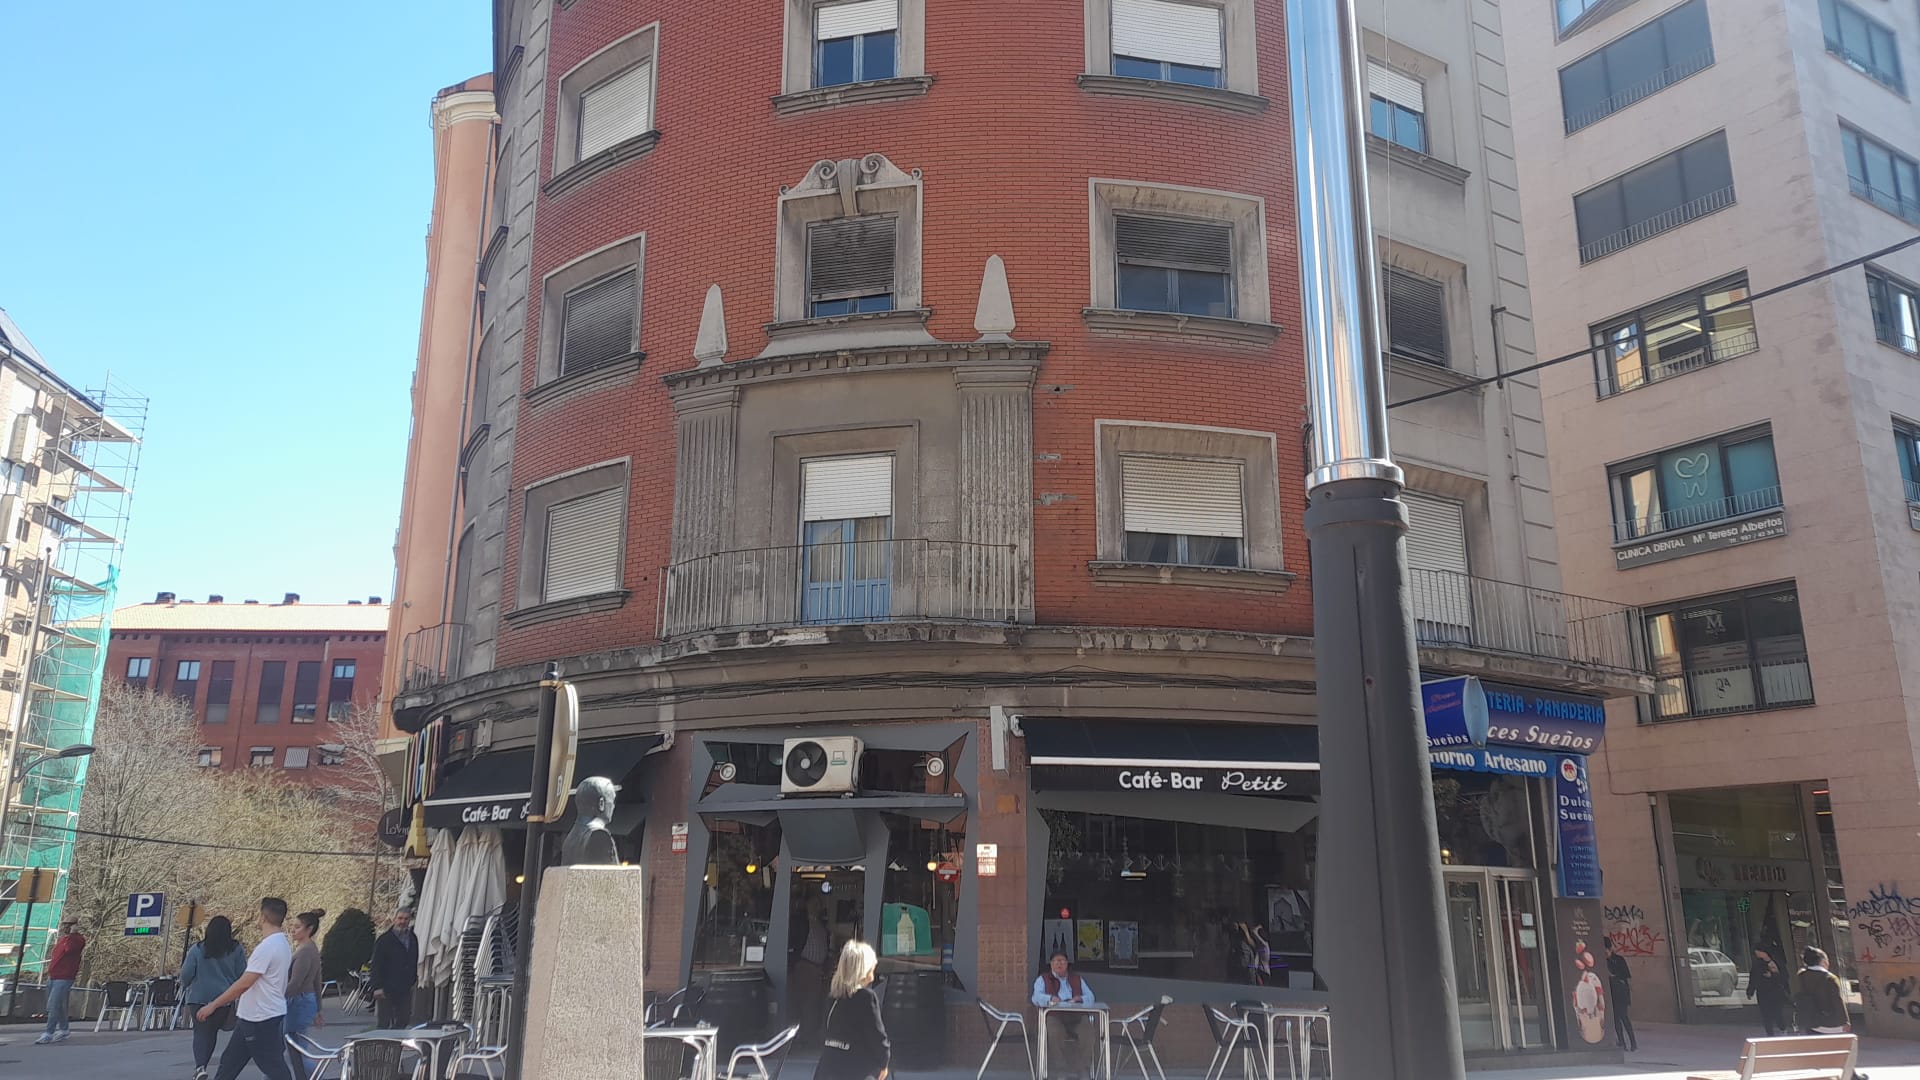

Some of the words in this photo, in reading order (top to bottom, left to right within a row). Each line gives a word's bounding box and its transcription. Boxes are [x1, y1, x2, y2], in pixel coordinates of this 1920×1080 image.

[1617, 546, 1652, 561] CLINICA
[1653, 538, 1686, 553] DENTAL
[1707, 528, 1739, 541] Teresa
[1741, 517, 1784, 534] Albertos
[1487, 691, 1524, 714] TERIA
[1536, 697, 1605, 724] PANADERIA
[1426, 732, 1469, 747] Sueños
[1487, 726, 1520, 740] ces
[1525, 725, 1593, 749] Sueños
[1484, 751, 1548, 774] Artesano
[1220, 770, 1288, 792] Petit
[135, 894, 155, 917] P
